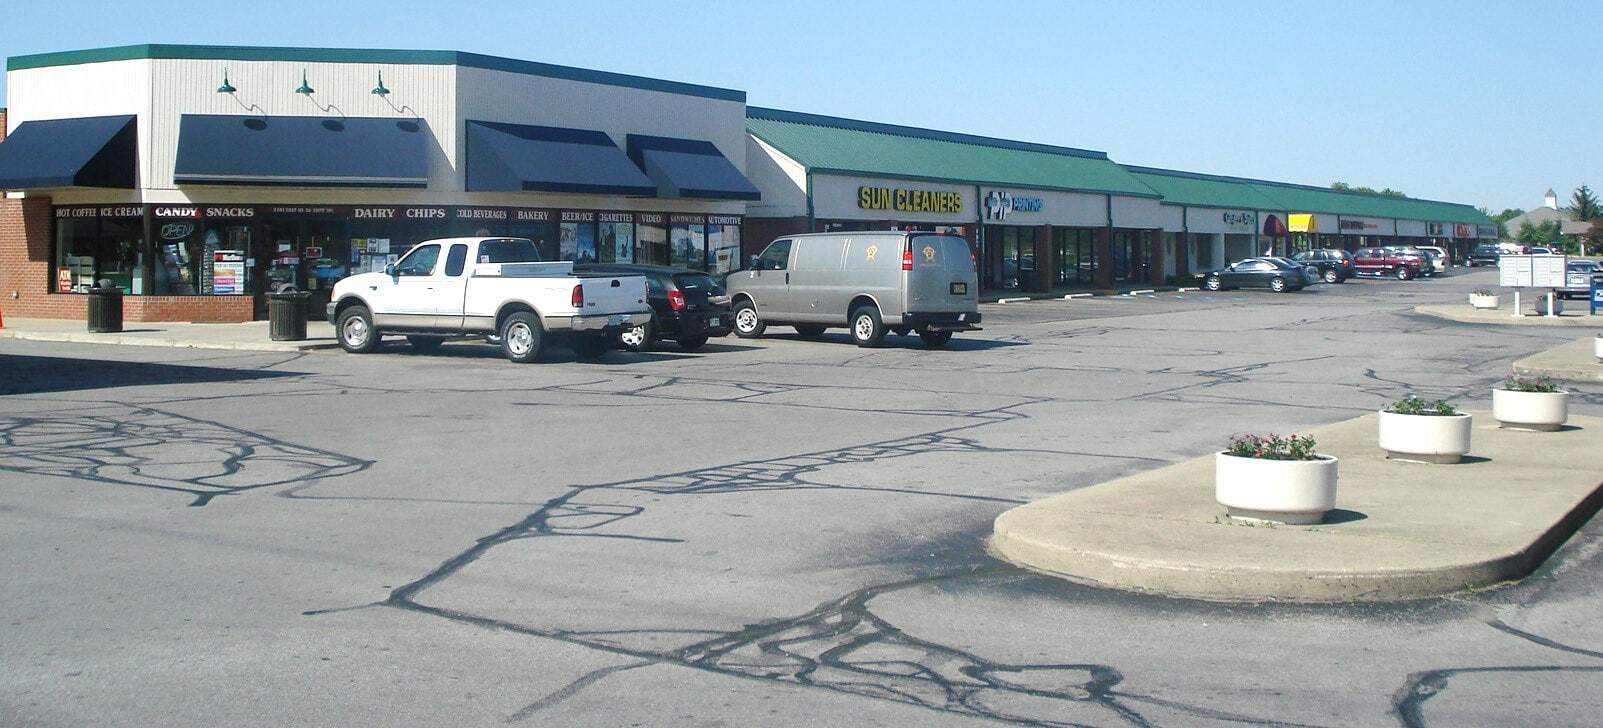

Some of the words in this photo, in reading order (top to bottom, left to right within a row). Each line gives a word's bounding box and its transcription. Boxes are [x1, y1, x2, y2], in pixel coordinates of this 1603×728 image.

[860, 186, 891, 210] SUN
[896, 189, 963, 213] CLEANERS
[1013, 197, 1044, 212] PRINTING
[56, 208, 70, 217] HOT
[72, 208, 97, 217] COFFEE
[100, 208, 112, 216] ICE
[114, 207, 144, 217] CREAM
[155, 207, 198, 217] CANDY
[206, 207, 254, 217] SNACKS
[354, 208, 395, 218] DAIRY
[406, 208, 446, 218] CHIPS
[456, 208, 473, 218] COLD
[473, 209, 507, 219] BEVERAGES
[518, 210, 549, 220] BAKERY
[561, 212, 593, 221] BEER/ICE
[641, 213, 662, 223] VIDEO
[670, 215, 705, 223] SANDWICHES
[162, 223, 193, 238] OPEN
